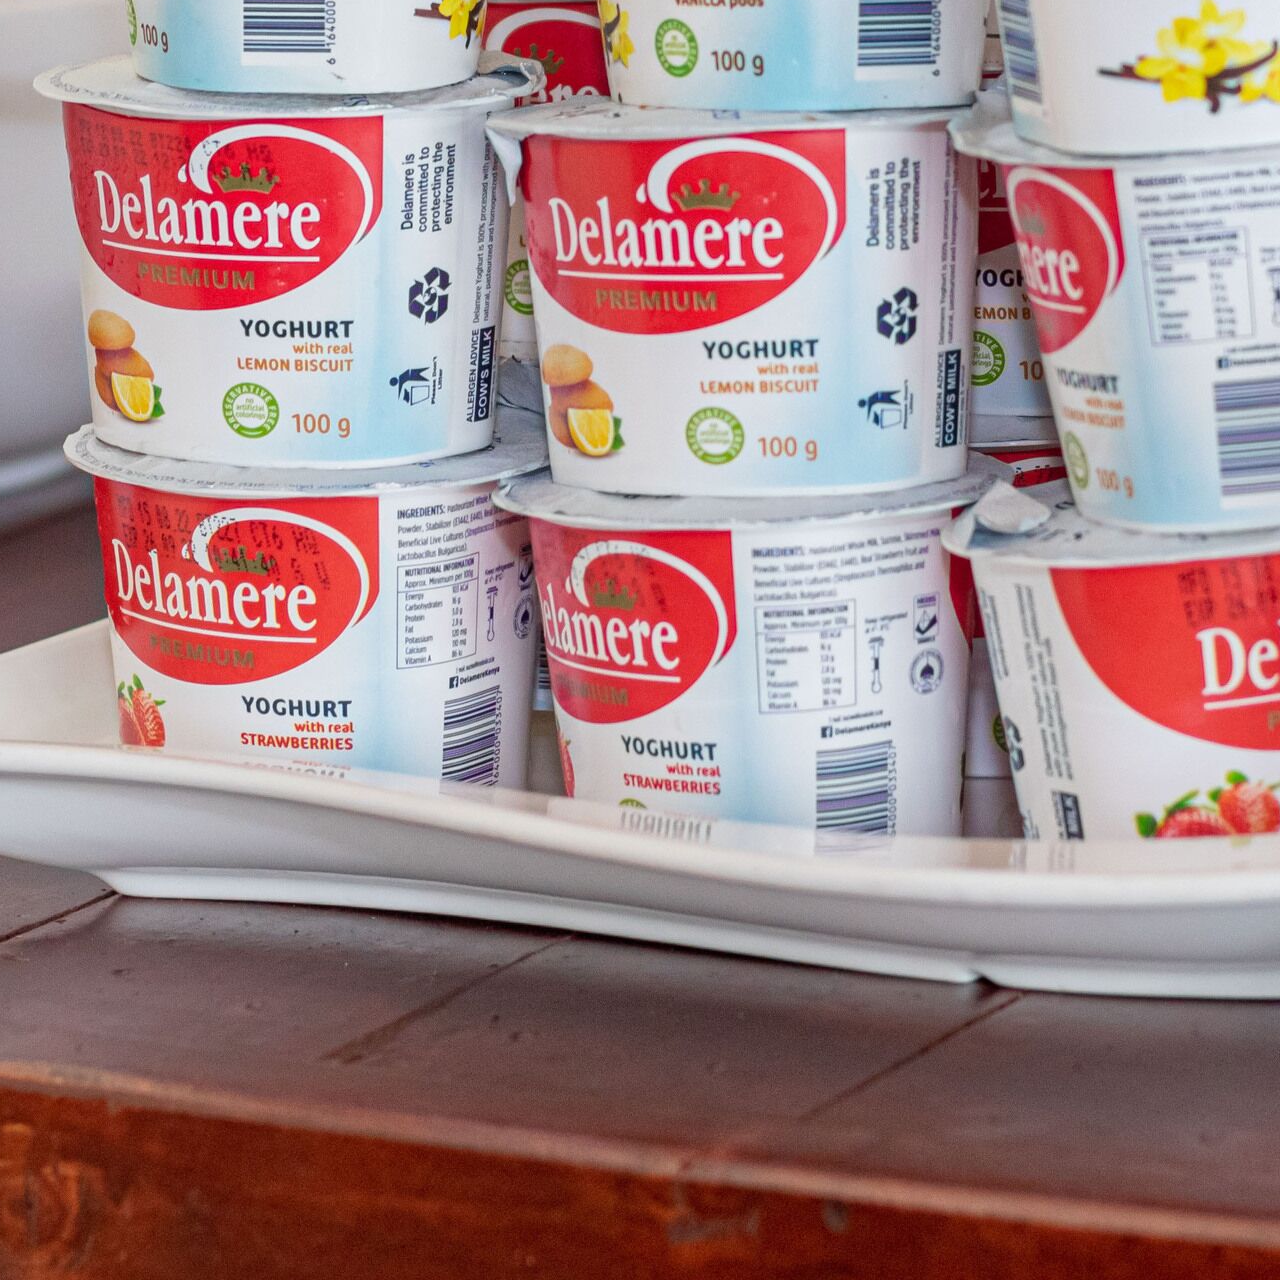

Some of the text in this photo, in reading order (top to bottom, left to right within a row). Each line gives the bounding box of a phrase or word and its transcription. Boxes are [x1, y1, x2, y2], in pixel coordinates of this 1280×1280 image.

[140, 23, 169, 53] 100 g
[711, 50, 765, 76] 100 g
[400, 153, 415, 231] Delamere is
[417, 146, 430, 233] committed to
[431, 141, 445, 233] protecting the
[443, 143, 456, 225] environment
[93, 169, 321, 251] Delamere
[480, 180, 489, 221] processed
[866, 167, 880, 247] Delamere is
[883, 161, 896, 250] committed to
[899, 157, 911, 251] protecting the
[911, 160, 921, 244] environment
[477, 222, 486, 242] 100%
[549, 197, 785, 270] Delamere
[138, 263, 256, 291] PREMIUM
[475, 251, 485, 285] Yoghurt
[473, 285, 483, 324] Delamere
[595, 288, 718, 313] PREMIUM
[240, 318, 354, 338] YOGHURT
[237, 357, 354, 372] LEMON BISCUIT
[293, 342, 353, 355] with real
[702, 339, 819, 360] YOGHURT
[466, 329, 480, 423] ALLERGEN ADVICE
[477, 329, 493, 418] COW'S MILK
[756, 363, 819, 375] with real
[946, 352, 958, 395] MILK
[700, 380, 819, 394] LEMON BISCUIT
[934, 351, 945, 448] ALLERGEN ADVICE
[223, 384, 278, 431] PRESERVATIVE FREE
[943, 396, 955, 446] COW'S
[291, 413, 351, 439] 100 g
[757, 436, 818, 462] 100 g
[397, 503, 446, 519] INGREDIENTS:
[405, 557, 475, 578] NUTRITIONAL INFORMATION
[111, 538, 317, 634] Delamere
[543, 584, 681, 671] elamere
[149, 633, 256, 670] PREMIUM
[459, 666, 500, 686] DelamereKenya
[241, 695, 352, 718] YOGHURT
[240, 732, 353, 750] STRAWBERRIES
[294, 721, 355, 733] with real
[621, 734, 717, 762] YOGHURT
[623, 773, 721, 795] STRAWBERRIES
[666, 762, 721, 778] with real
